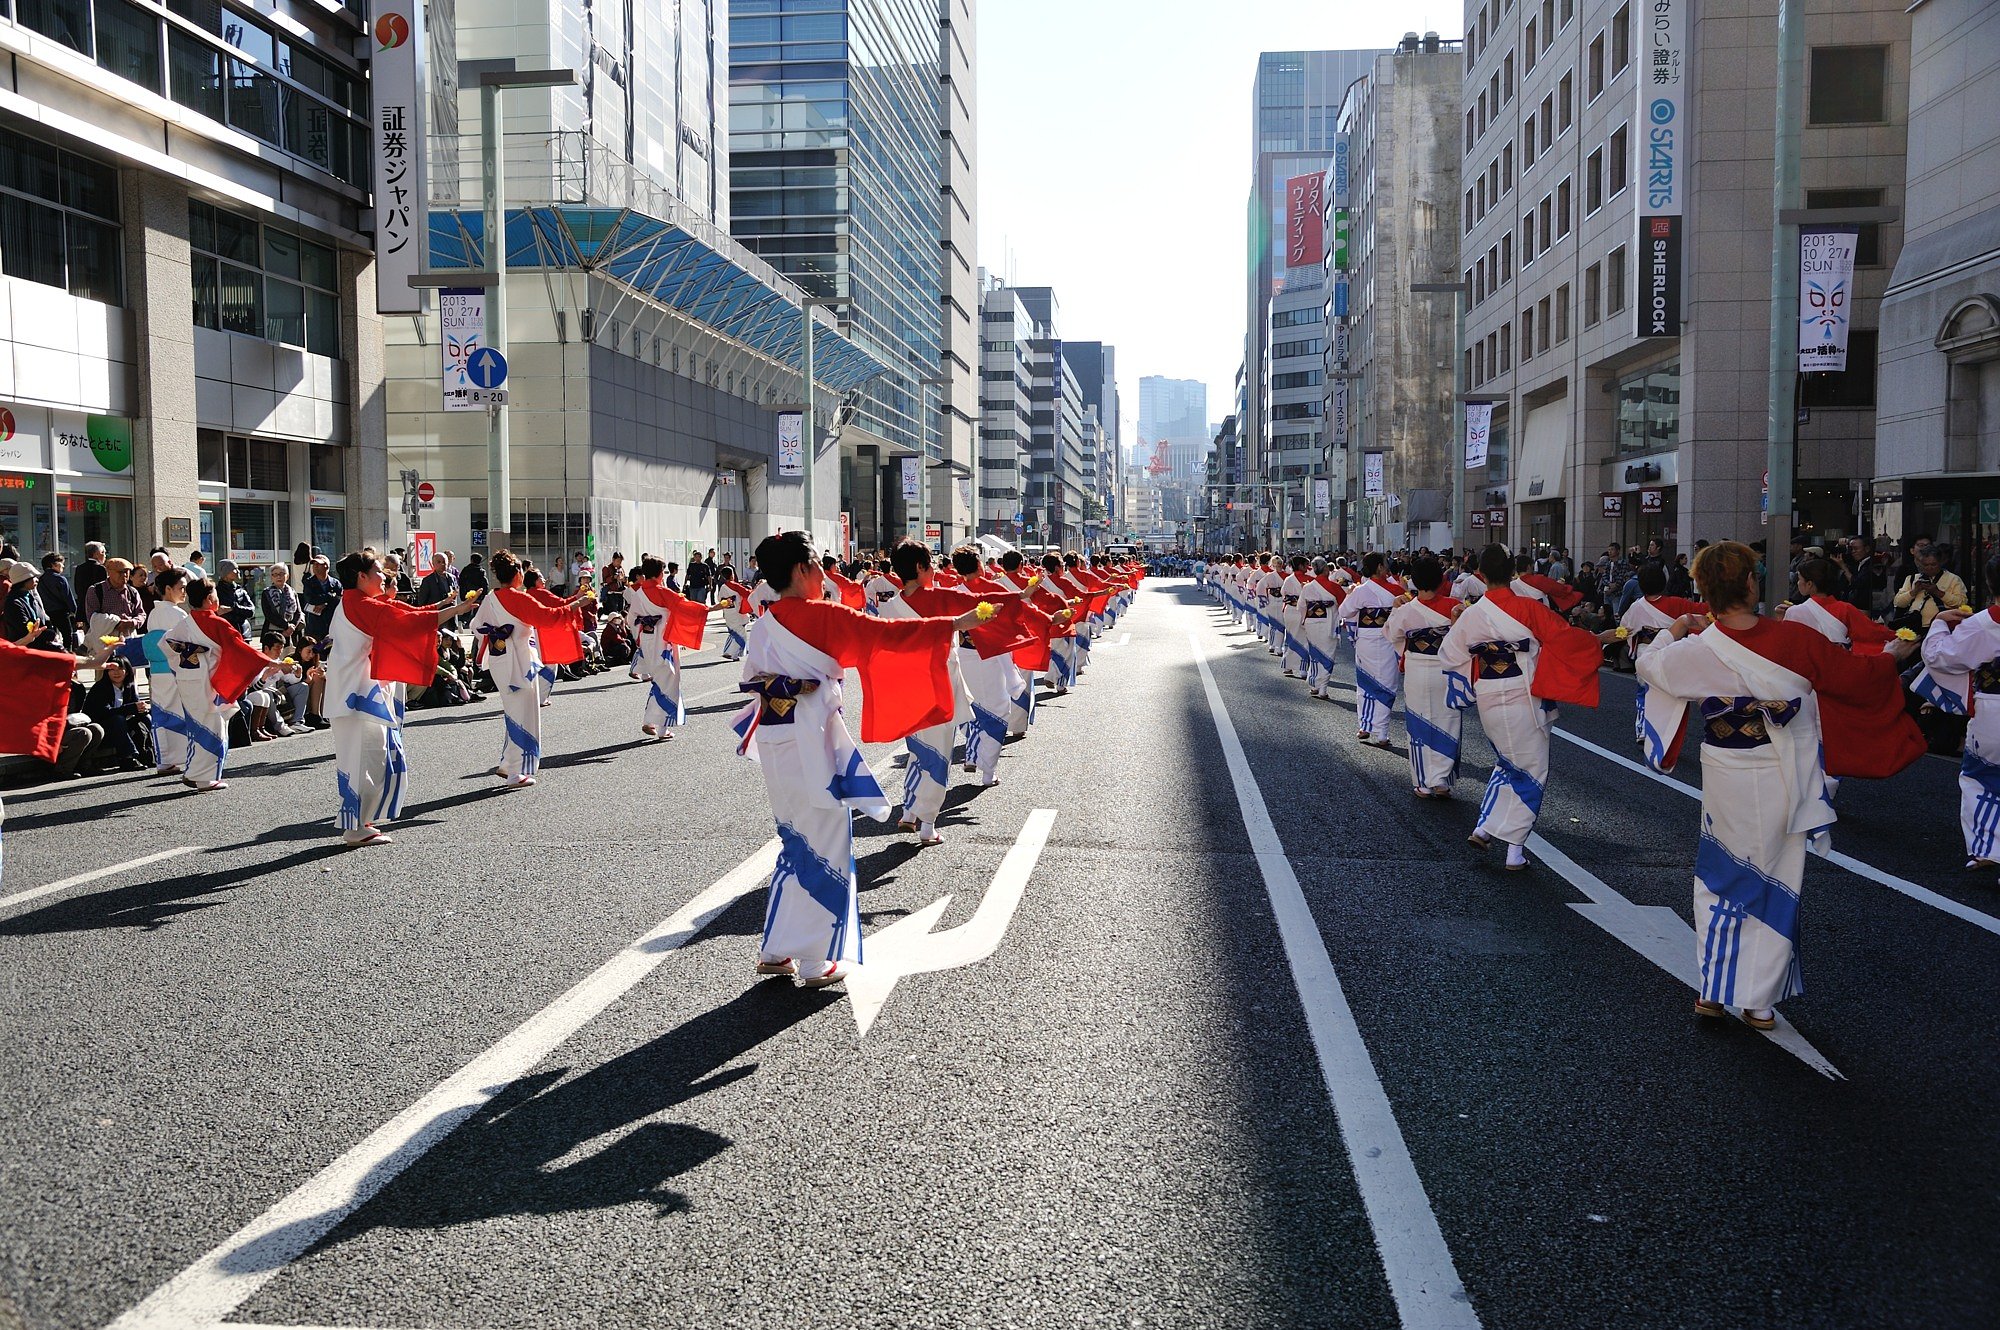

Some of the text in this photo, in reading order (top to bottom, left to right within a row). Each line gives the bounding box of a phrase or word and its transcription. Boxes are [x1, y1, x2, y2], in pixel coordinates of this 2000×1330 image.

[1671, 49, 1681, 84] グループ
[382, 106, 409, 254] 証券ジャパン
[1336, 156, 1347, 196] STARTS
[1649, 128, 1672, 209] STARTS
[1308, 175, 1320, 216] ワタベ
[1803, 235, 1835, 247] 2013
[1803, 261, 1833, 272] SUN
[442, 296, 467, 306] 2013
[1652, 240, 1666, 334] SHERLOCK
[443, 317, 465, 328] SUN
[59, 432, 121, 451] あなたとともに
